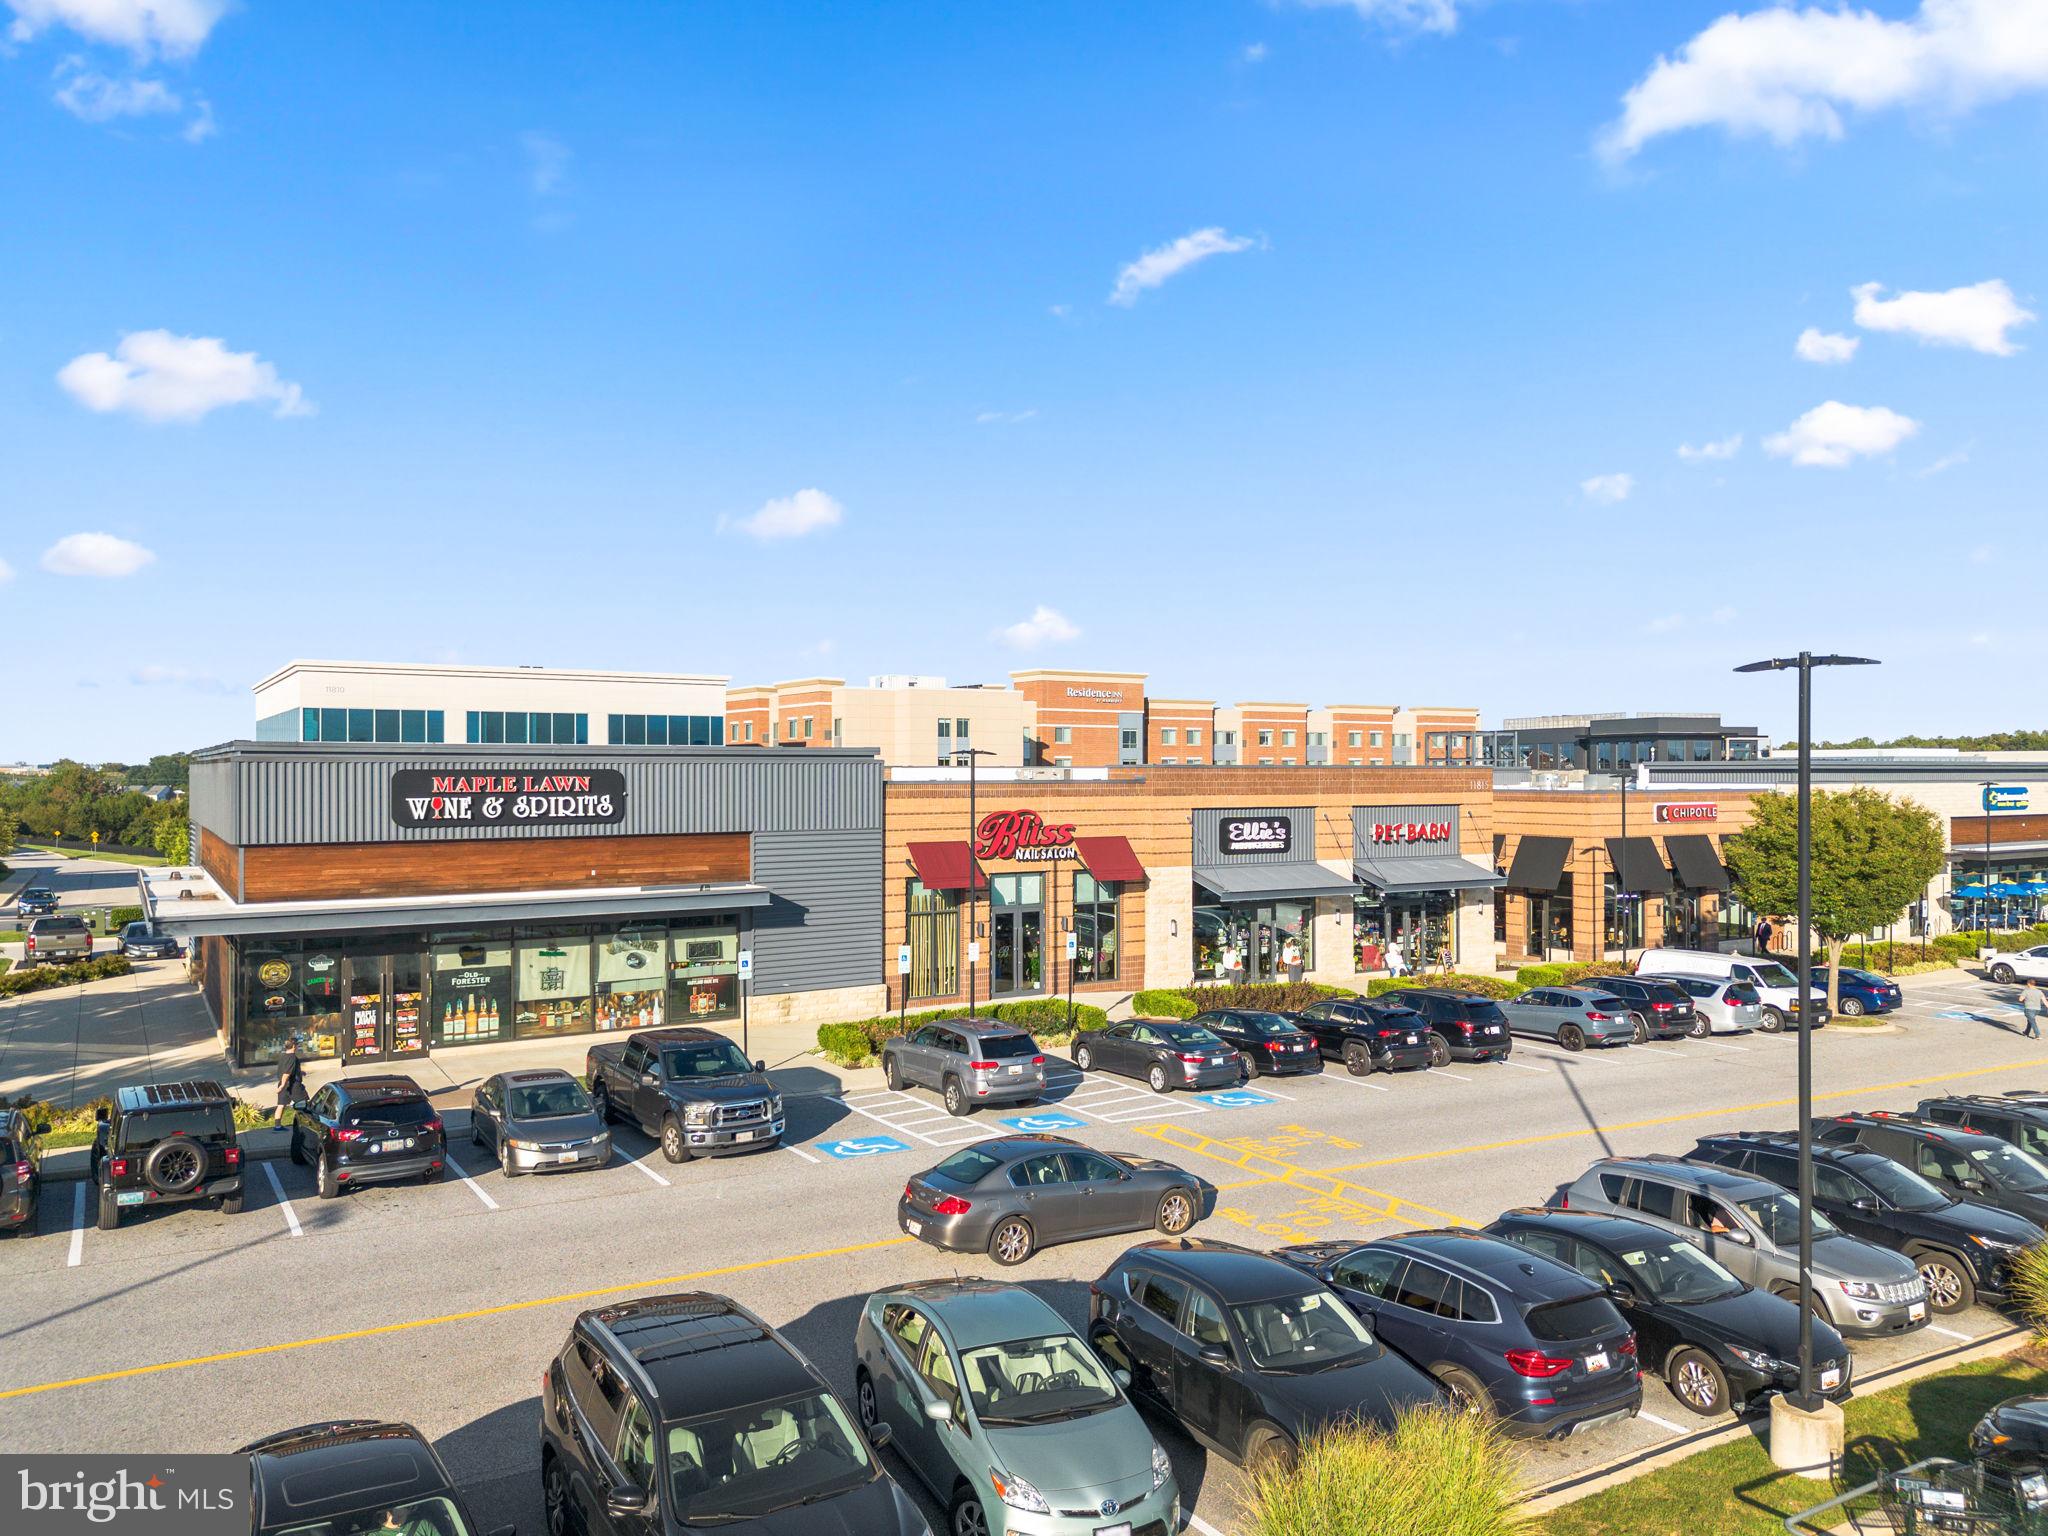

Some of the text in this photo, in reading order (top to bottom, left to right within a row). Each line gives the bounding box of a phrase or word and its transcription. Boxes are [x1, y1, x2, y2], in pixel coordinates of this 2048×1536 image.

[1066, 687, 1112, 698] Residence
[432, 776, 591, 793] MAPLE LAWN
[405, 795, 614, 820] WINE & SPIRITS
[1673, 807, 1717, 818] CHIPOTLE
[974, 809, 1075, 859] Bliss
[1229, 821, 1287, 841] Ellie's
[1372, 821, 1452, 842] PET BARN
[1015, 847, 1075, 860] NAIL SALON
[451, 976, 491, 986] FORESTER
